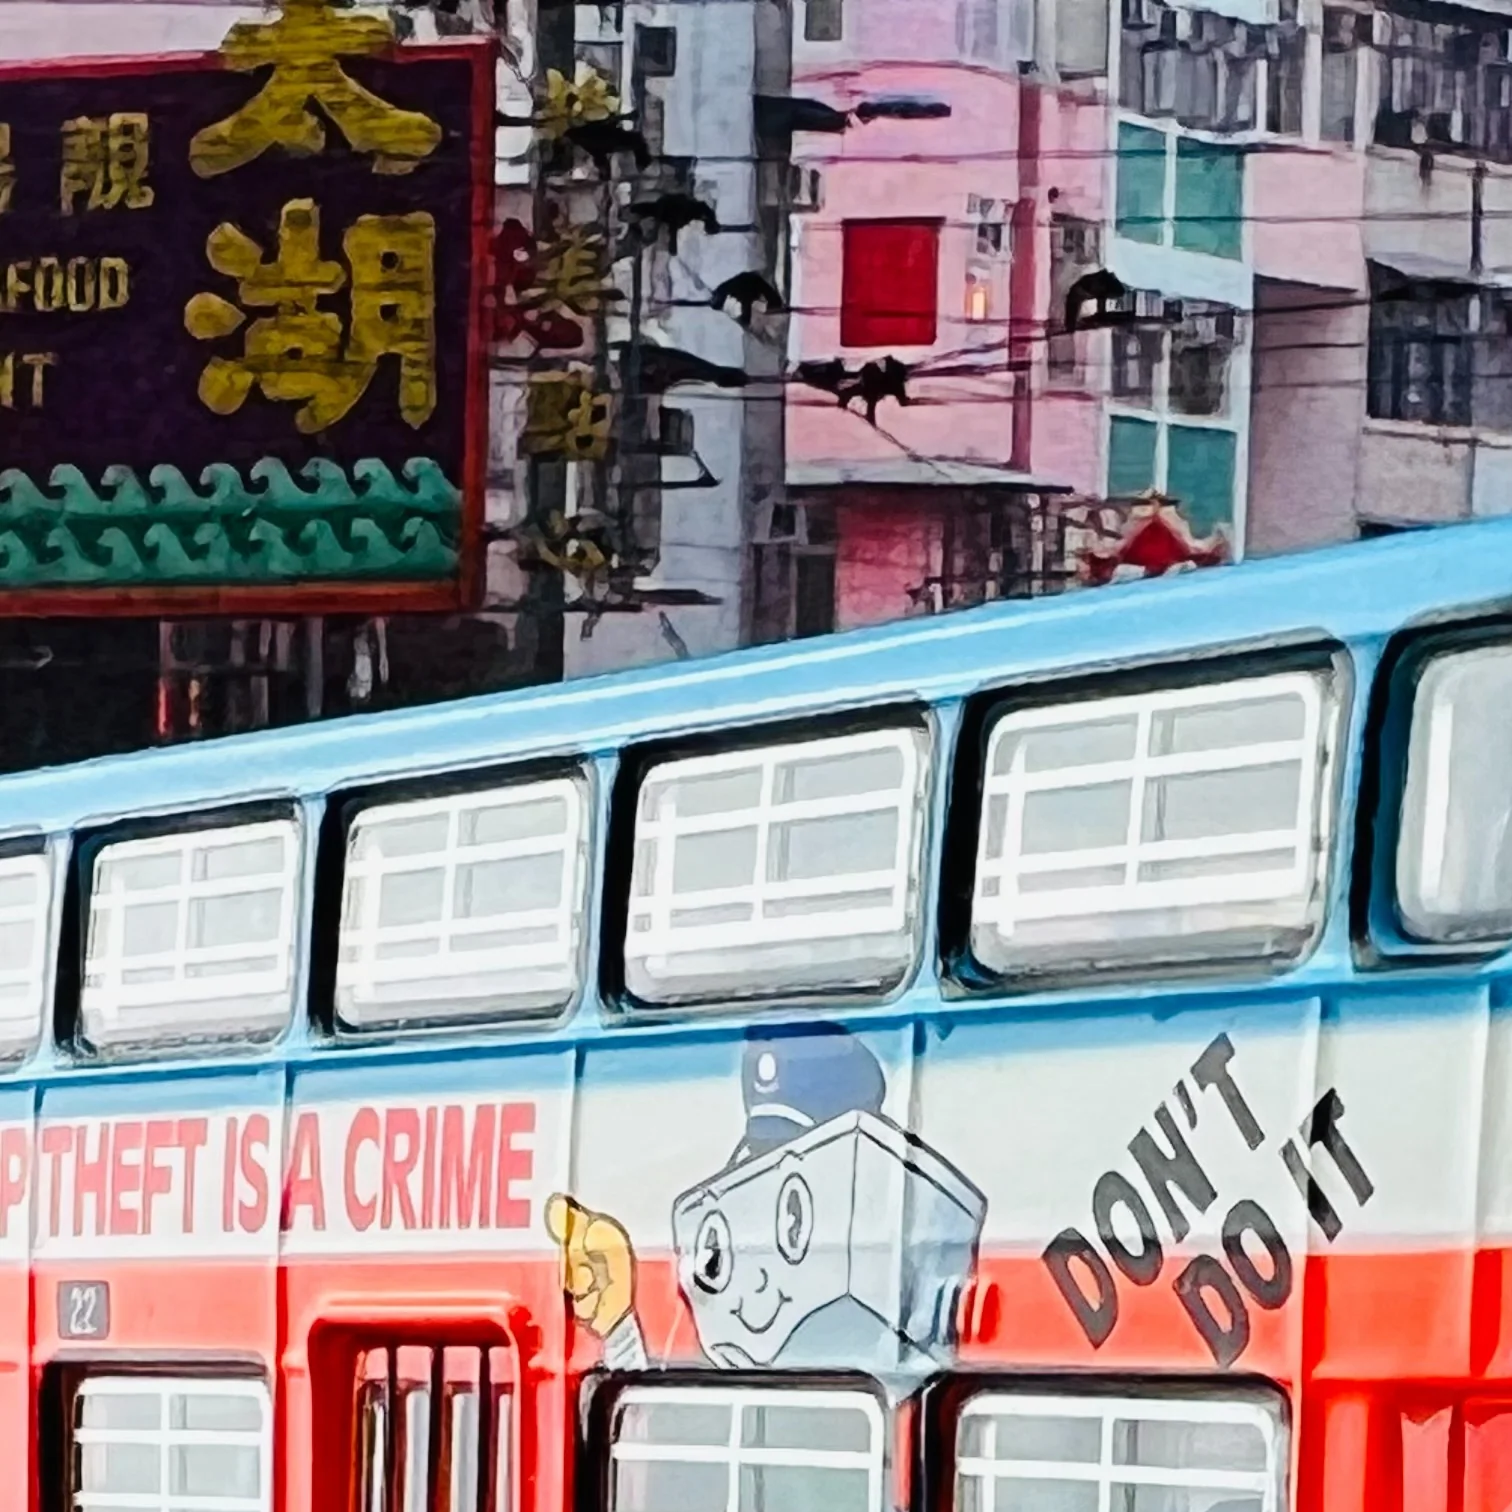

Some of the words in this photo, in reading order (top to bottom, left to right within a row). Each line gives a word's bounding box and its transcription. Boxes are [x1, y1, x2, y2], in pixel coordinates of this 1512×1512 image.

[42, 1117, 209, 1236] THEFT
[223, 1114, 270, 1233] IS
[279, 1112, 327, 1233] A
[344, 1102, 537, 1234] CRIME
[1041, 1031, 1266, 1350] DON'T
[1172, 1198, 1293, 1369] DO
[1279, 1087, 1375, 1242] IT
[68, 1285, 100, 1336] 22
